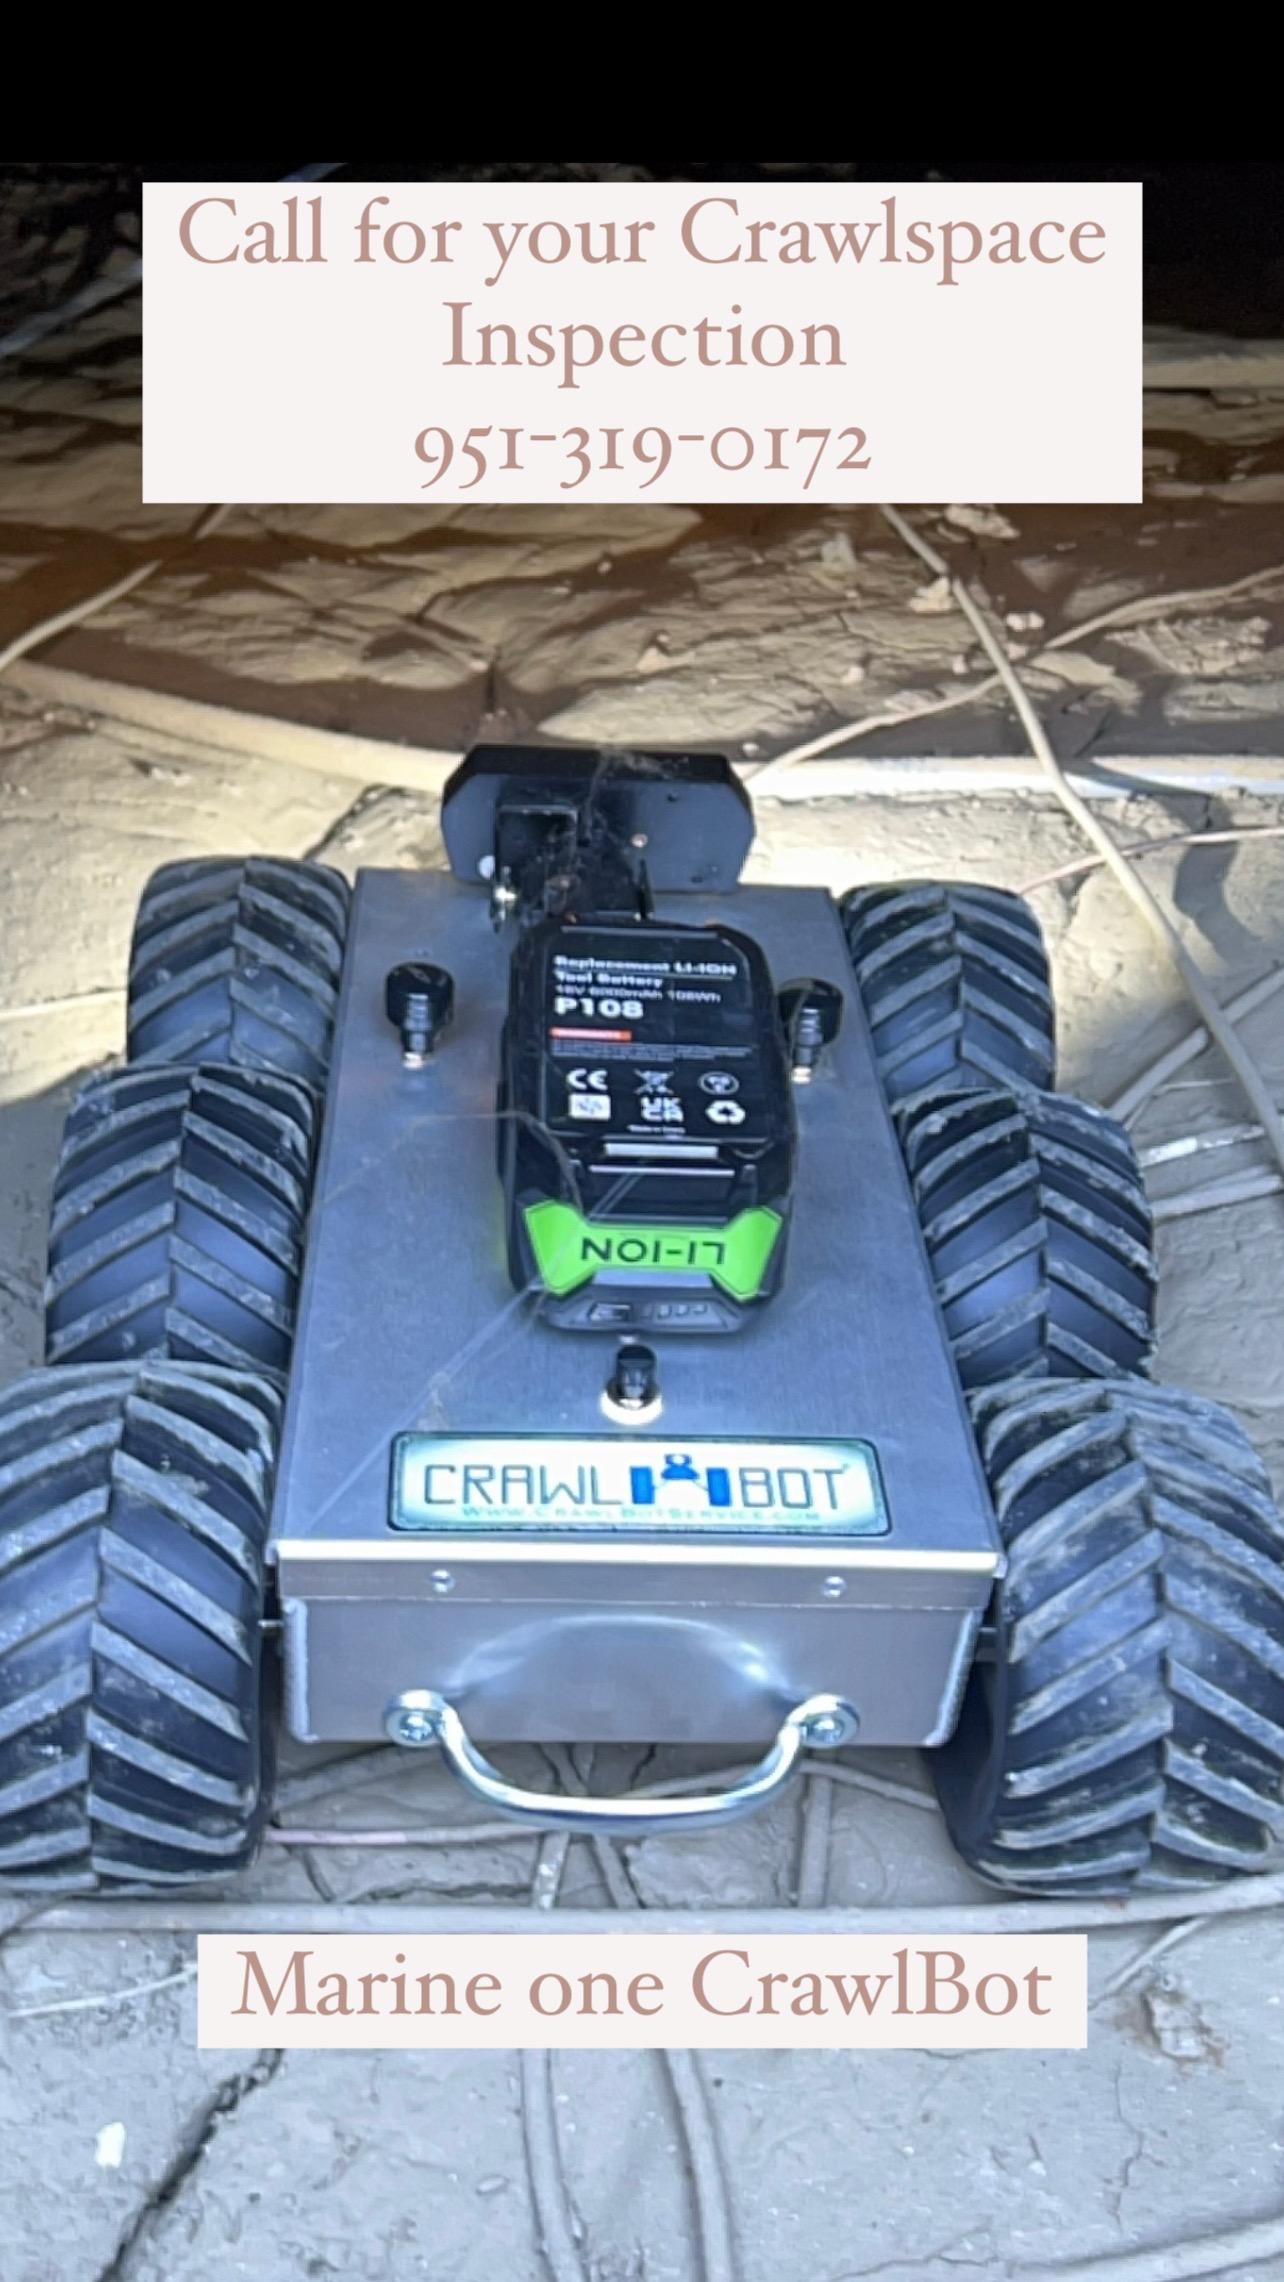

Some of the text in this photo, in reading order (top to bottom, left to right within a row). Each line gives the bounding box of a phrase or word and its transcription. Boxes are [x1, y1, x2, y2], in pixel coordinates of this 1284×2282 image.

[554, 956, 670, 972] Replacement
[554, 973, 663, 987] Tool Battery
[554, 998, 644, 1018] P108
[581, 1236, 726, 1266] LI-ION
[423, 1462, 844, 1510] CRAWL BOT
